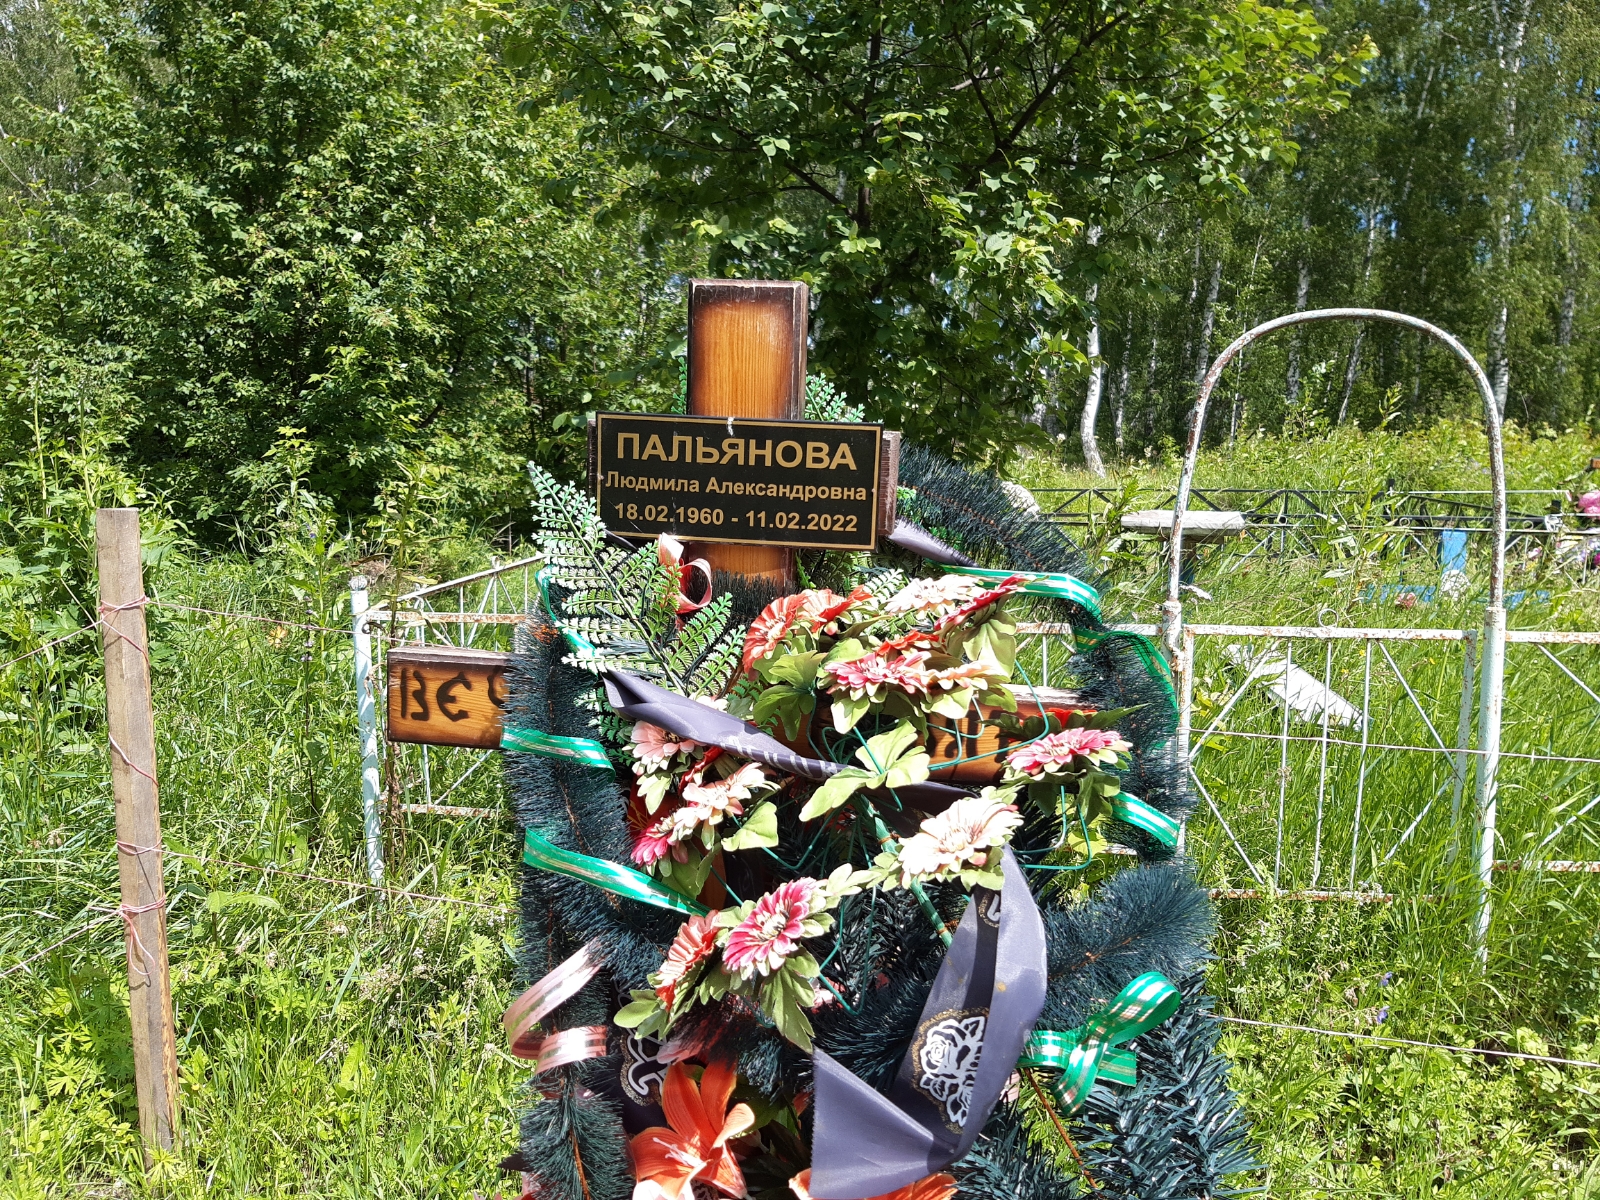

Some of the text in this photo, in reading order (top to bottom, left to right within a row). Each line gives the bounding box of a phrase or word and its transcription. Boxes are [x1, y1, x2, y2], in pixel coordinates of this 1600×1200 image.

[617, 432, 858, 471] ПАЛЬЯНОВА
[605, 470, 867, 503] Людмила Александровна
[615, 502, 725, 525] 18.02.1960
[745, 510, 858, 532] 11.02.2022
